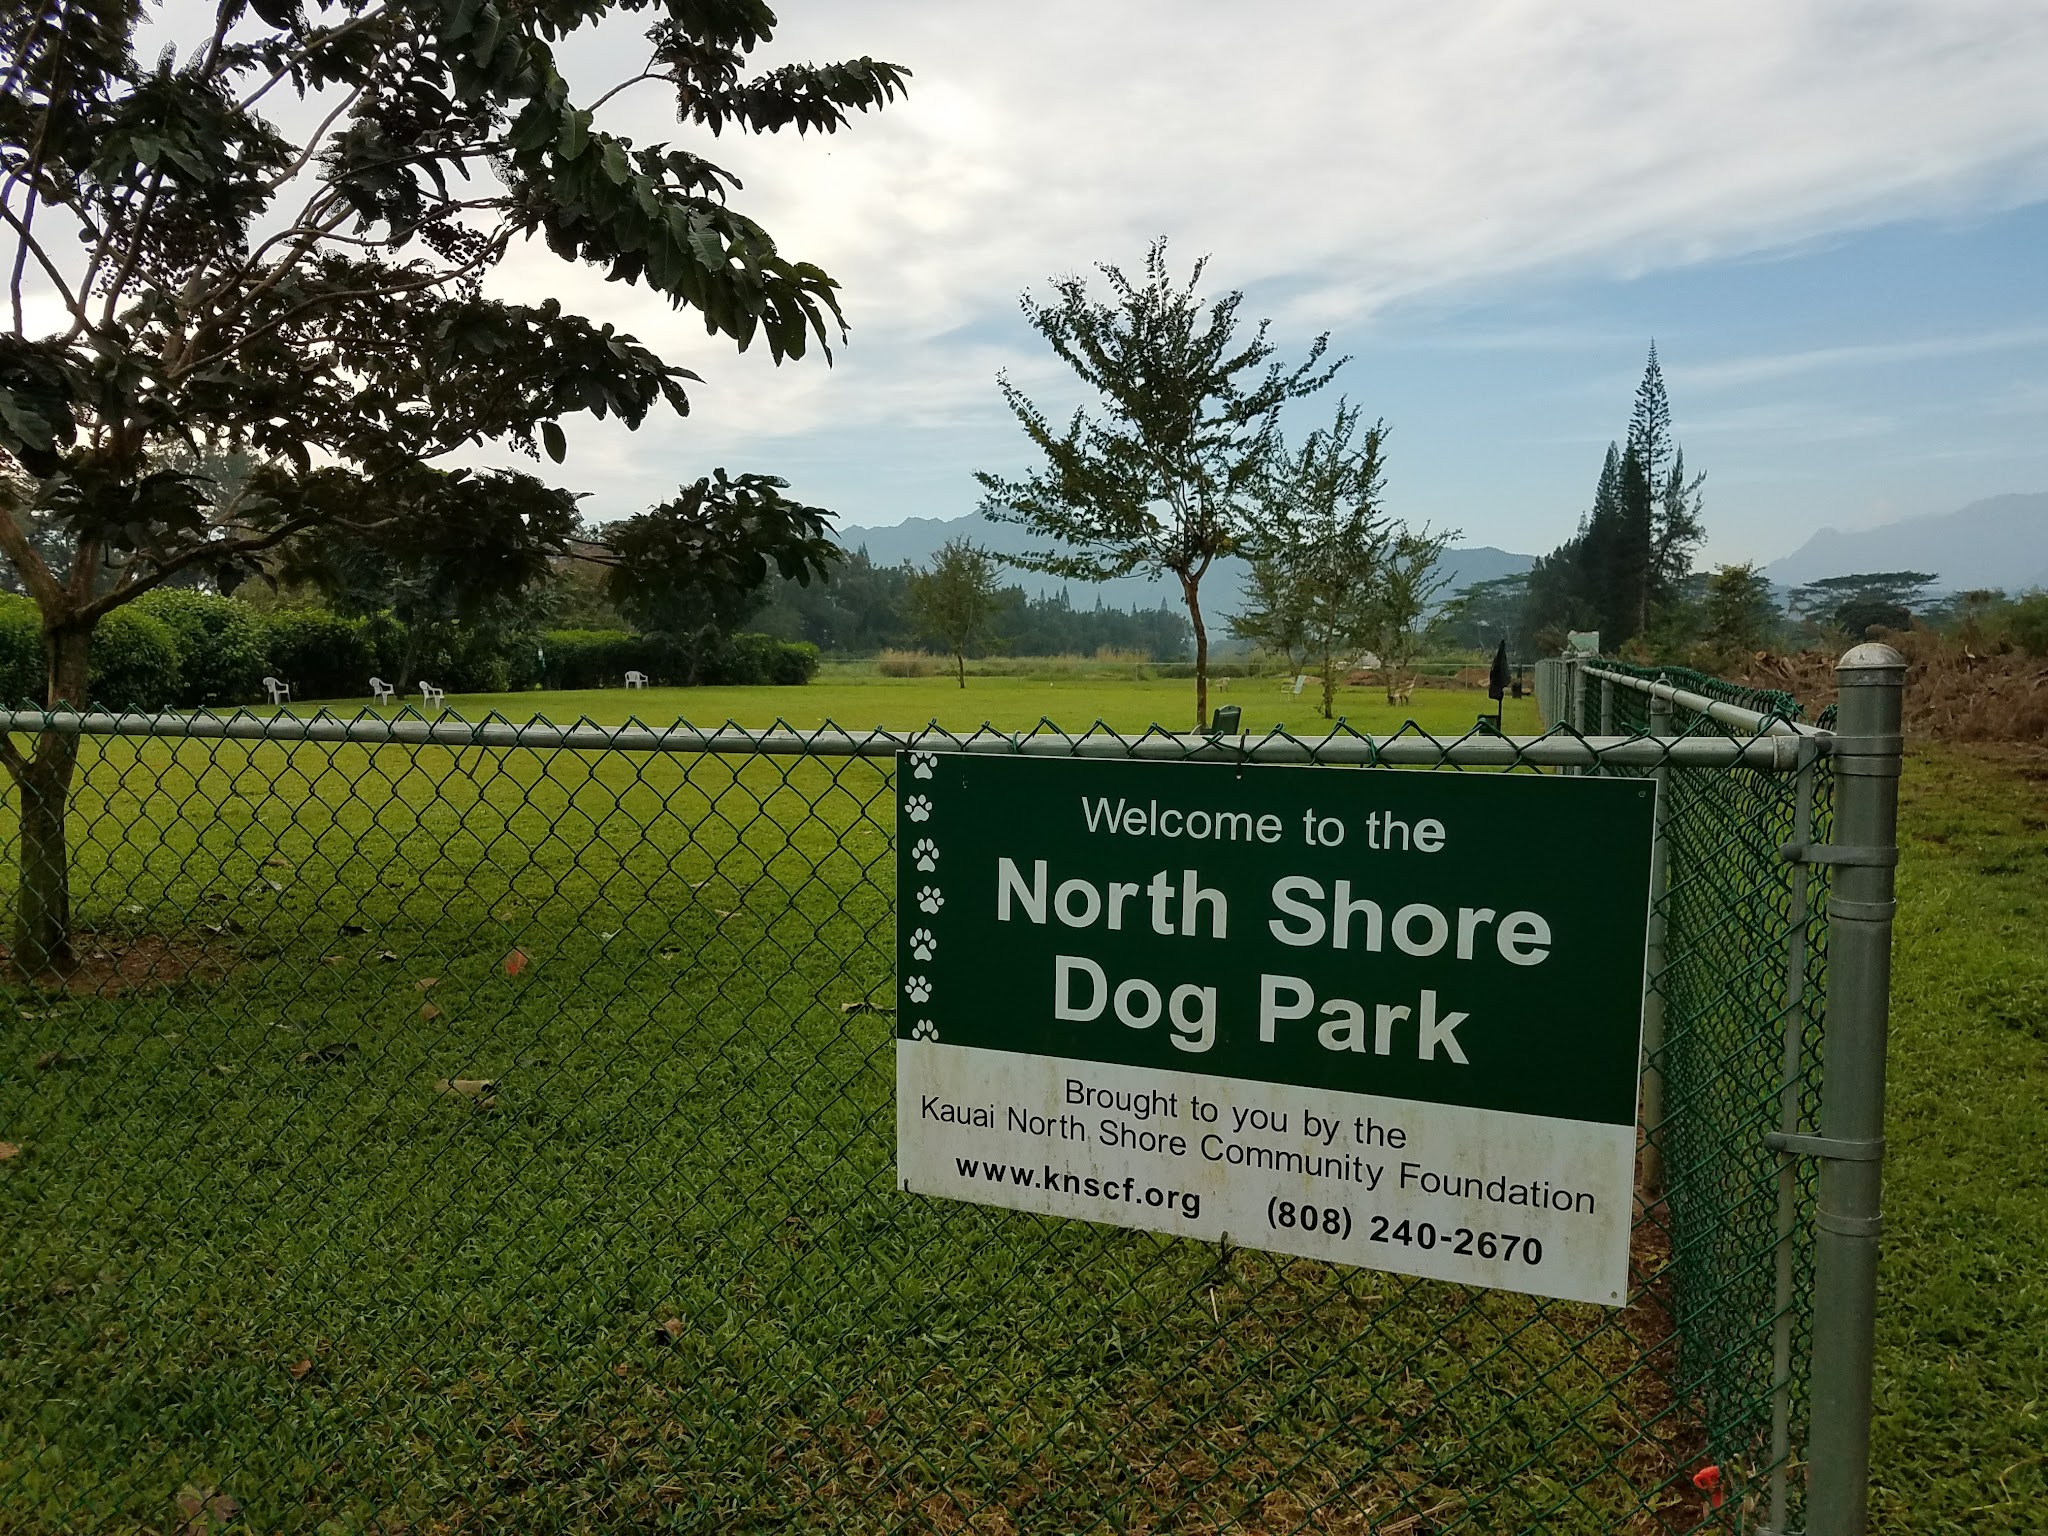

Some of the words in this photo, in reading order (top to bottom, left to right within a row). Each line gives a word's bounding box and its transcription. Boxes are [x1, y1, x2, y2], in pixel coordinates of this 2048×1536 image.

[1082, 797, 1282, 842] Welcome
[1303, 808, 1344, 846] to
[1366, 811, 1445, 852] the
[998, 858, 1227, 938] North
[1269, 876, 1551, 965] Shore
[1055, 955, 1216, 1052] Dog
[1260, 974, 1469, 1064] Park
[1066, 1078, 1178, 1121] Brought
[1191, 1096, 1217, 1122] to
[1231, 1105, 1288, 1135] you
[1305, 1109, 1340, 1146] by
[1354, 1117, 1406, 1148] the
[923, 1095, 993, 1128] Kauai
[1009, 1107, 1084, 1141] North
[1100, 1120, 1186, 1155] Shore
[1200, 1134, 1384, 1191] Community
[1401, 1162, 1594, 1214] Foundation
[956, 1158, 1201, 1219] www.knscf.org
[1268, 1197, 1351, 1240] (808)
[1370, 1216, 1542, 1265] 240-2670
